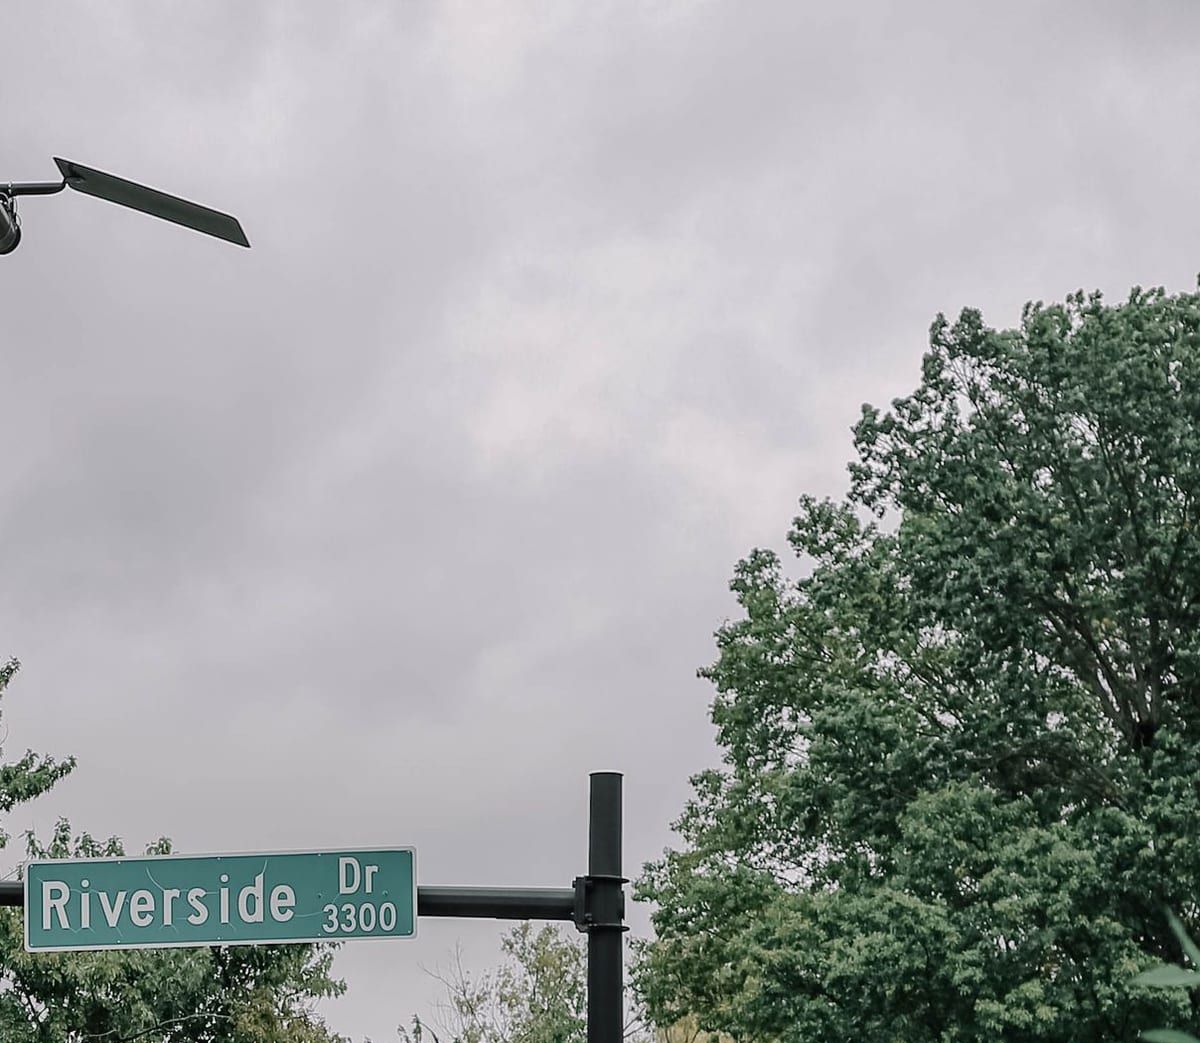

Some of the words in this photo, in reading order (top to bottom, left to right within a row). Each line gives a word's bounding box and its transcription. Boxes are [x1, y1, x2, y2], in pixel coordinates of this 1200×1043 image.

[41, 873, 296, 930] Riverside
[338, 856, 379, 894] Dr
[321, 902, 397, 933] 3300
